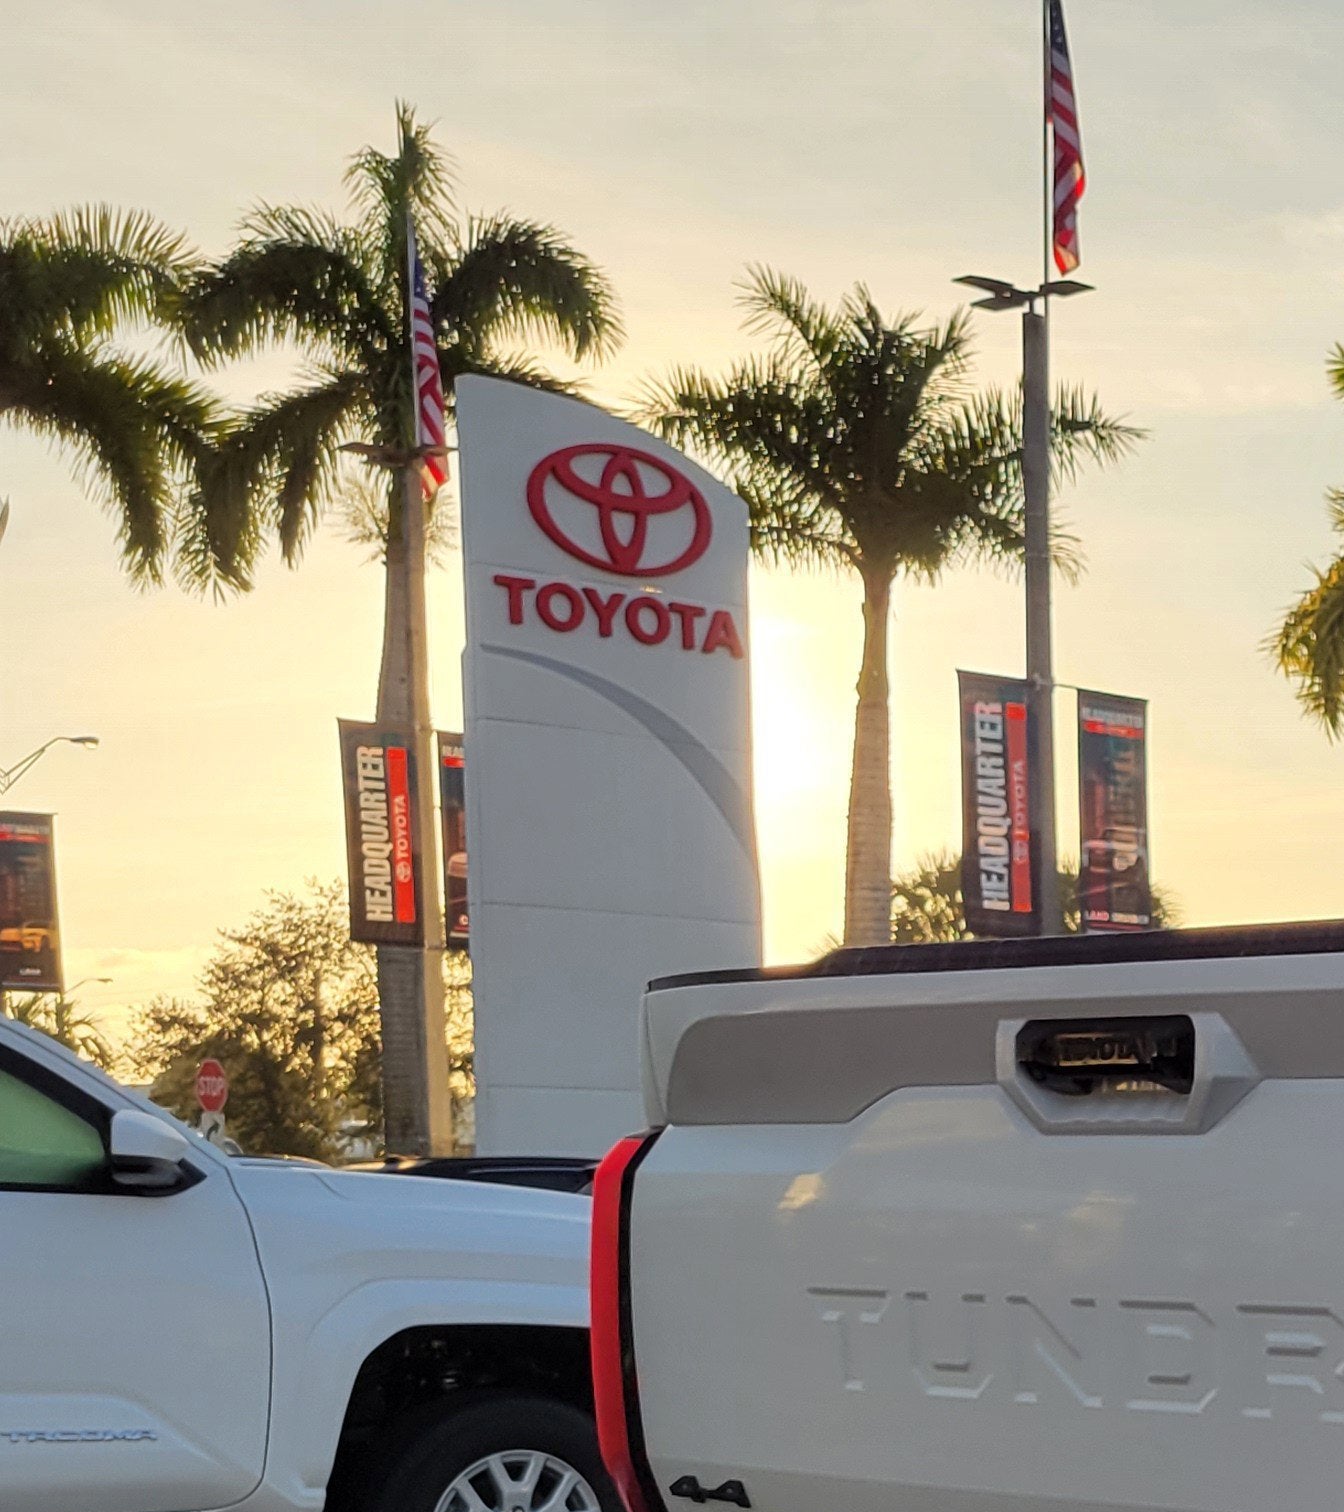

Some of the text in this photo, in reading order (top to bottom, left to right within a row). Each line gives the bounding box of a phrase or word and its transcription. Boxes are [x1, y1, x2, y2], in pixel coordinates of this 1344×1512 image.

[494, 574, 744, 660] TOYOTA
[356, 745, 394, 923] HEADQUARTER
[394, 795, 410, 860] TOYOTA
[974, 701, 1012, 911] HEADQUARTER
[1012, 761, 1029, 840] TOYOTA
[199, 1076, 225, 1096] STOP
